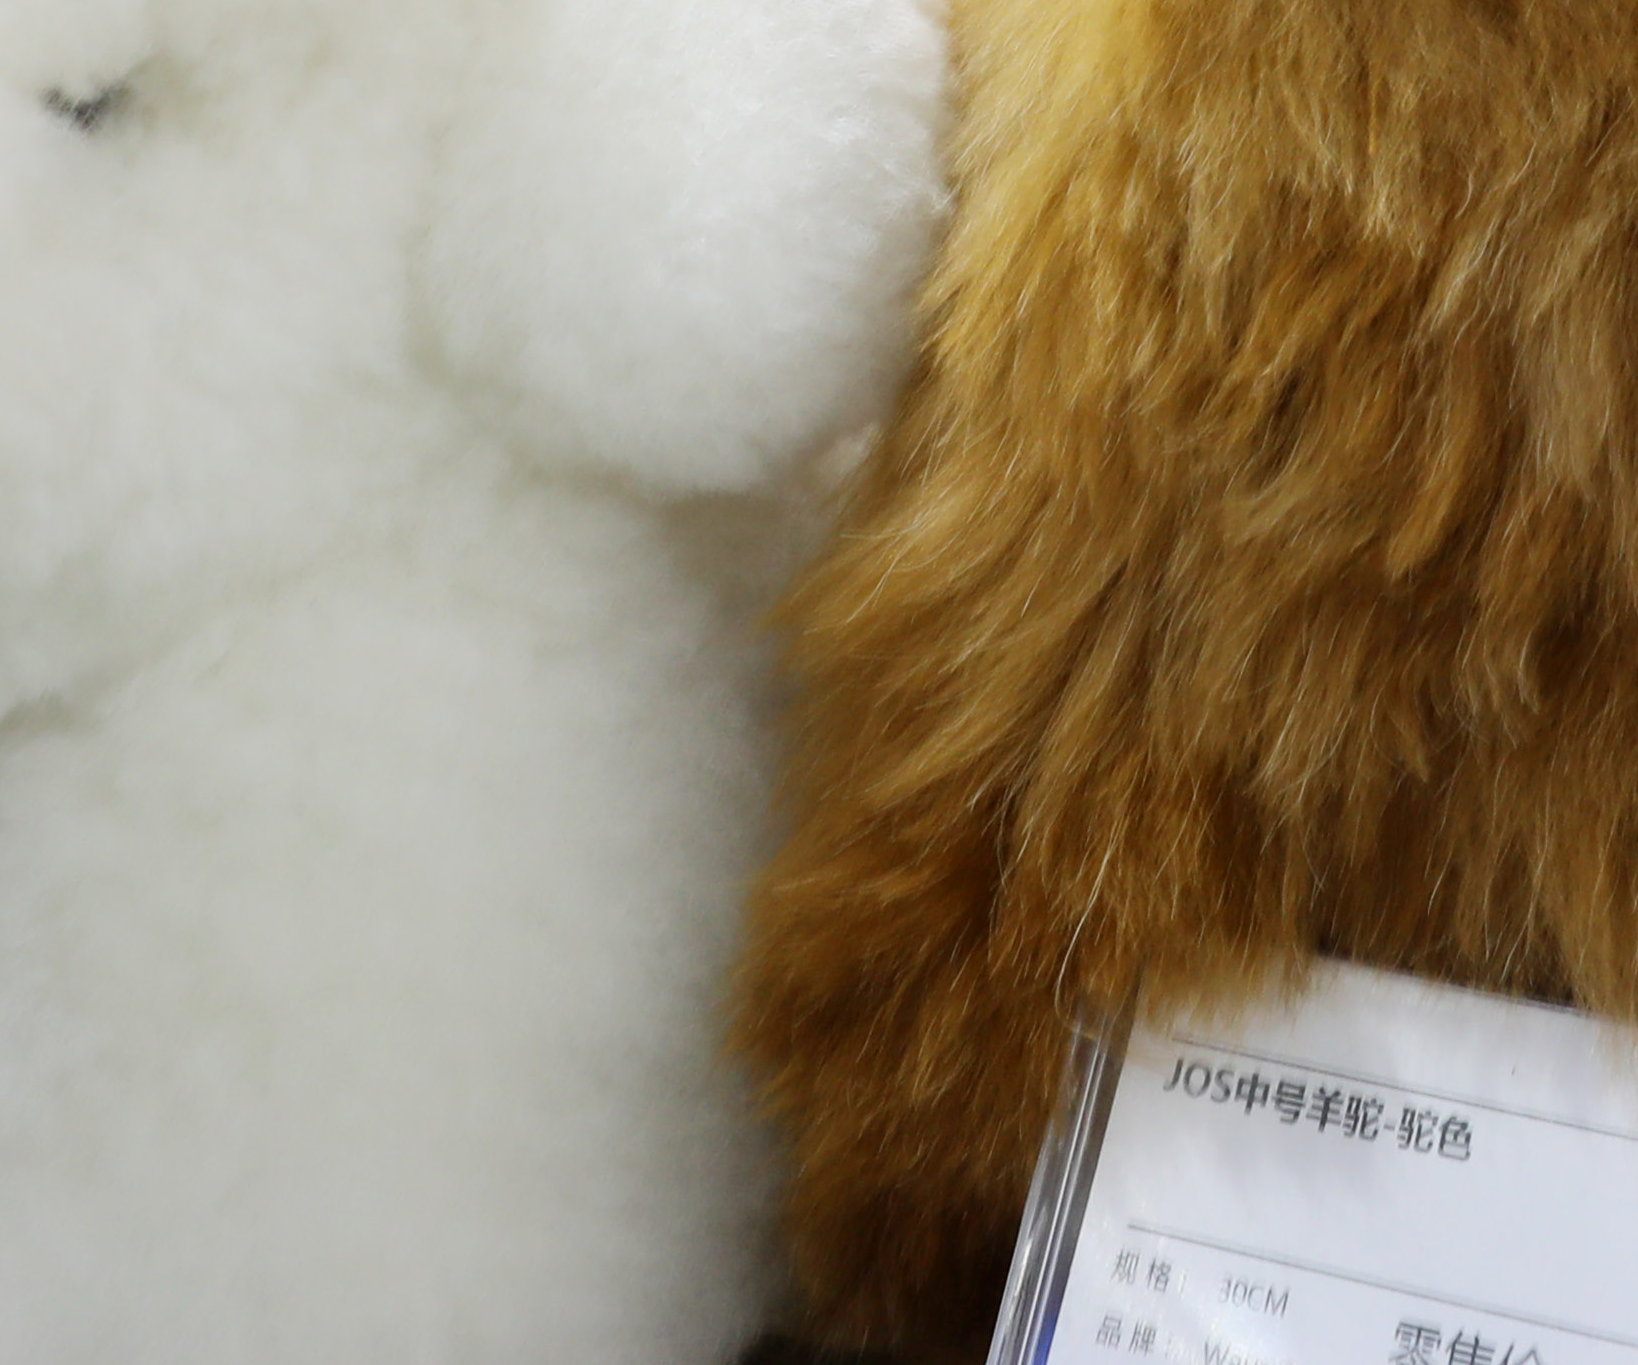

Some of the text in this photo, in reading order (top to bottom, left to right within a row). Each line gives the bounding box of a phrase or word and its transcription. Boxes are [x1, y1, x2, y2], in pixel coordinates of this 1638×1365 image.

[1163, 1057, 1473, 1161] JOS中号羊驼-驼色
[1218, 1271, 1290, 1318] 30CM
